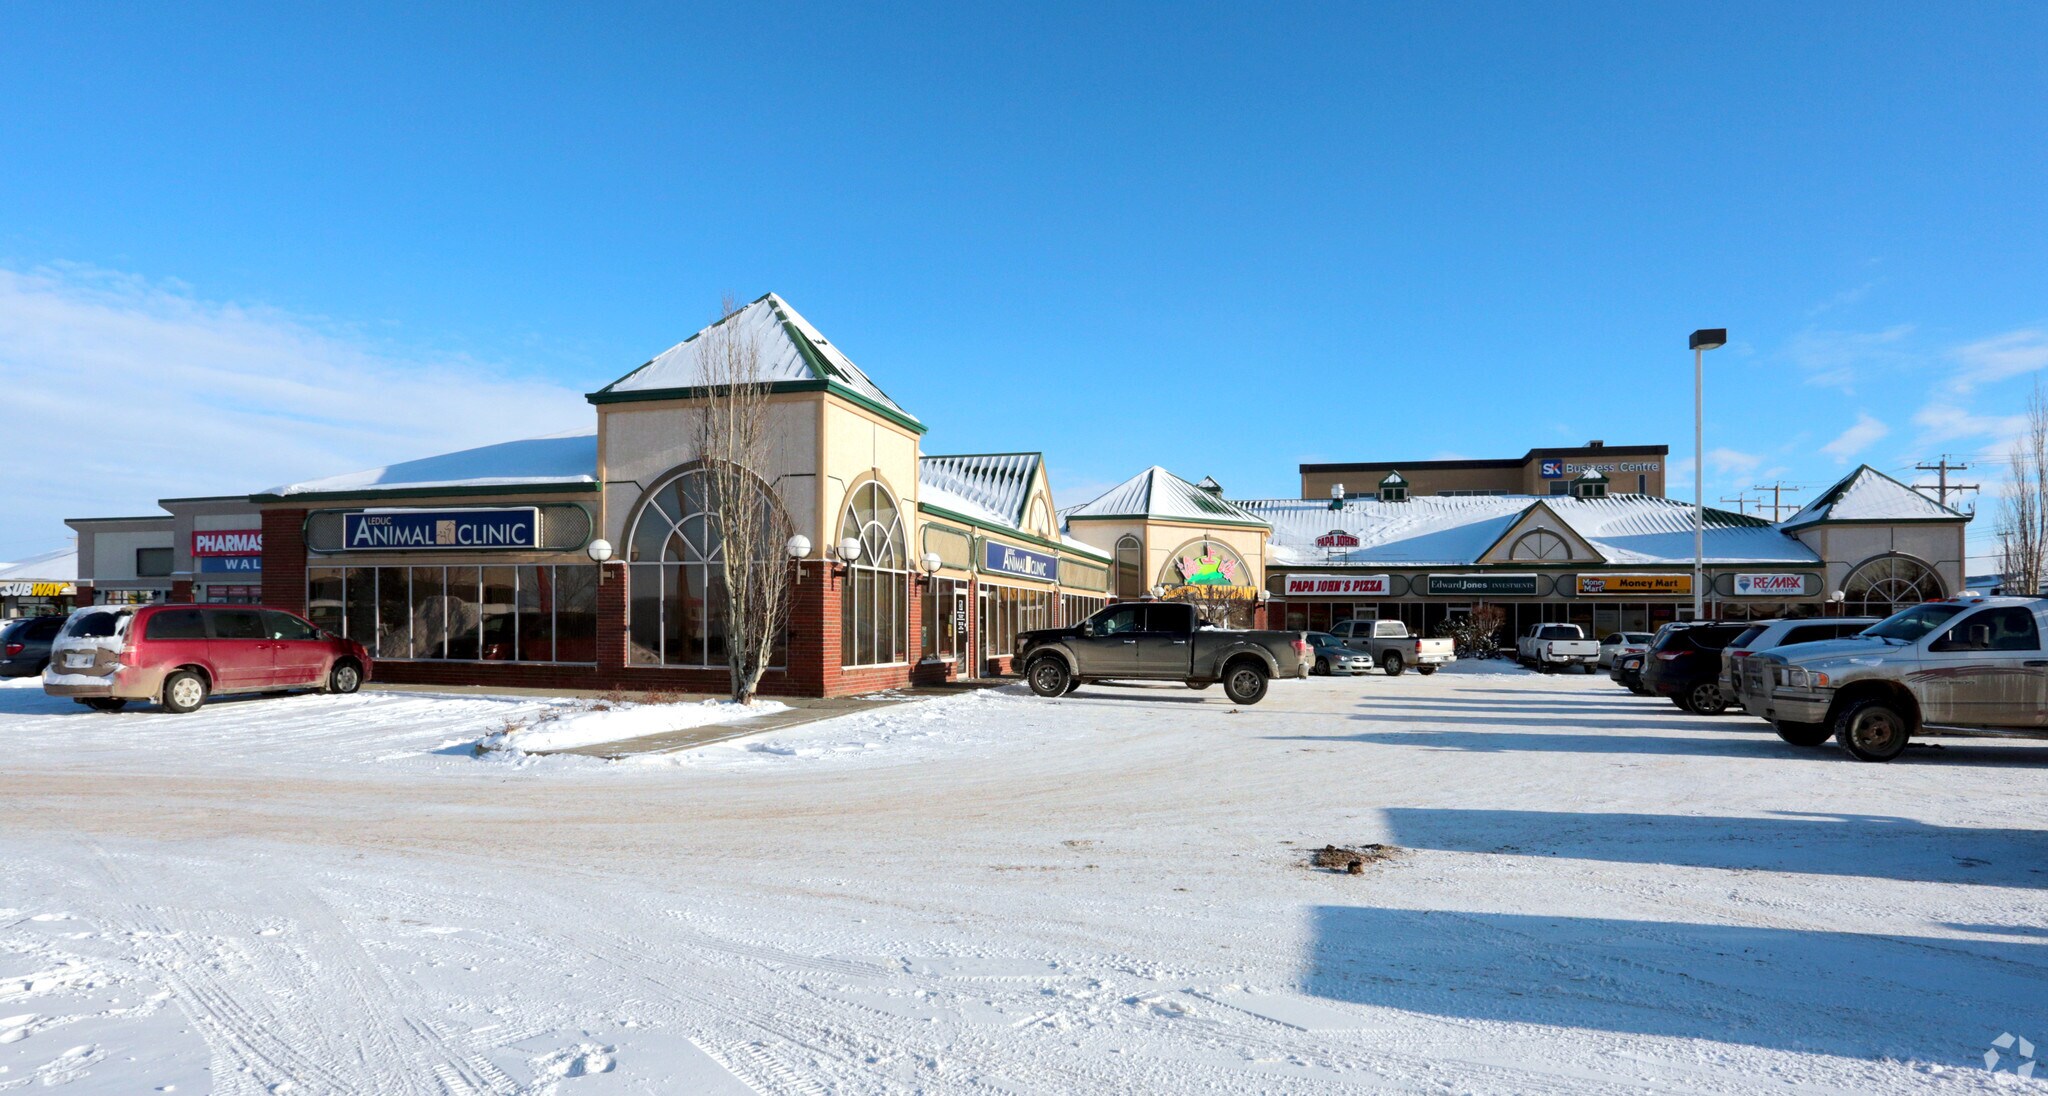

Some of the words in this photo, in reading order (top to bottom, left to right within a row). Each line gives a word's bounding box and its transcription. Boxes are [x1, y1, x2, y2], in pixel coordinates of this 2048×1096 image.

[1542, 463, 1562, 475] SK
[1566, 463, 1615, 473] Busess
[1620, 462, 1659, 472] Centre
[367, 517, 392, 525] LEDUC
[353, 516, 435, 546] ANIMAL
[458, 523, 526, 545] CLINIC
[1317, 535, 1334, 547] PAPA
[1002, 547, 1026, 573] ANIMAL
[1030, 559, 1047, 577] CLINIC
[1289, 580, 1314, 592] PAPA
[1316, 580, 1351, 592] JOHN'S
[1352, 580, 1383, 592] PIZZA
[1431, 580, 1462, 589] Edward
[1462, 580, 1488, 590] Jones
[1619, 579, 1653, 589] Money
[1655, 579, 1678, 587] Mart
[1753, 576, 1801, 589] RE/MAX
[0, 582, 71, 597] SUBWAY
[1196, 584, 1257, 600] RETAURANT
